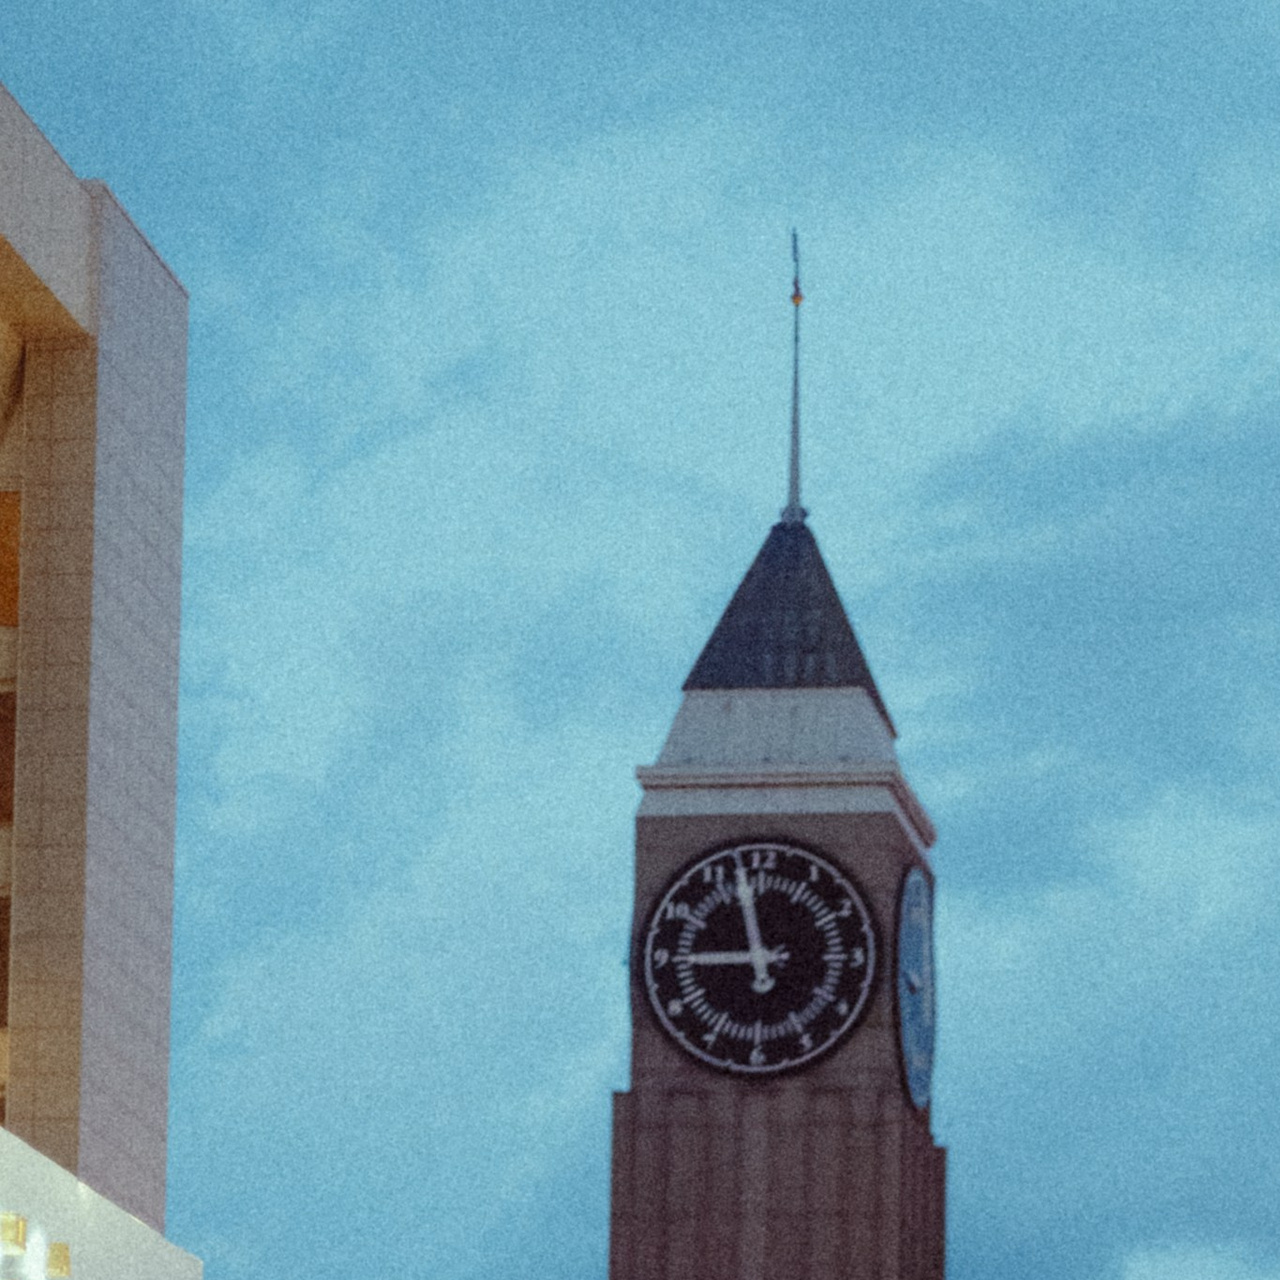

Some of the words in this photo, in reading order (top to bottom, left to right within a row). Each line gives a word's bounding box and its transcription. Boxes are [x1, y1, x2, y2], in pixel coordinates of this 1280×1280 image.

[751, 851, 776, 869] 12
[703, 866, 724, 884] 11
[809, 865, 818, 881] 1
[666, 902, 690, 920] 10
[654, 948, 669, 969] 9
[850, 946, 865, 968] 3
